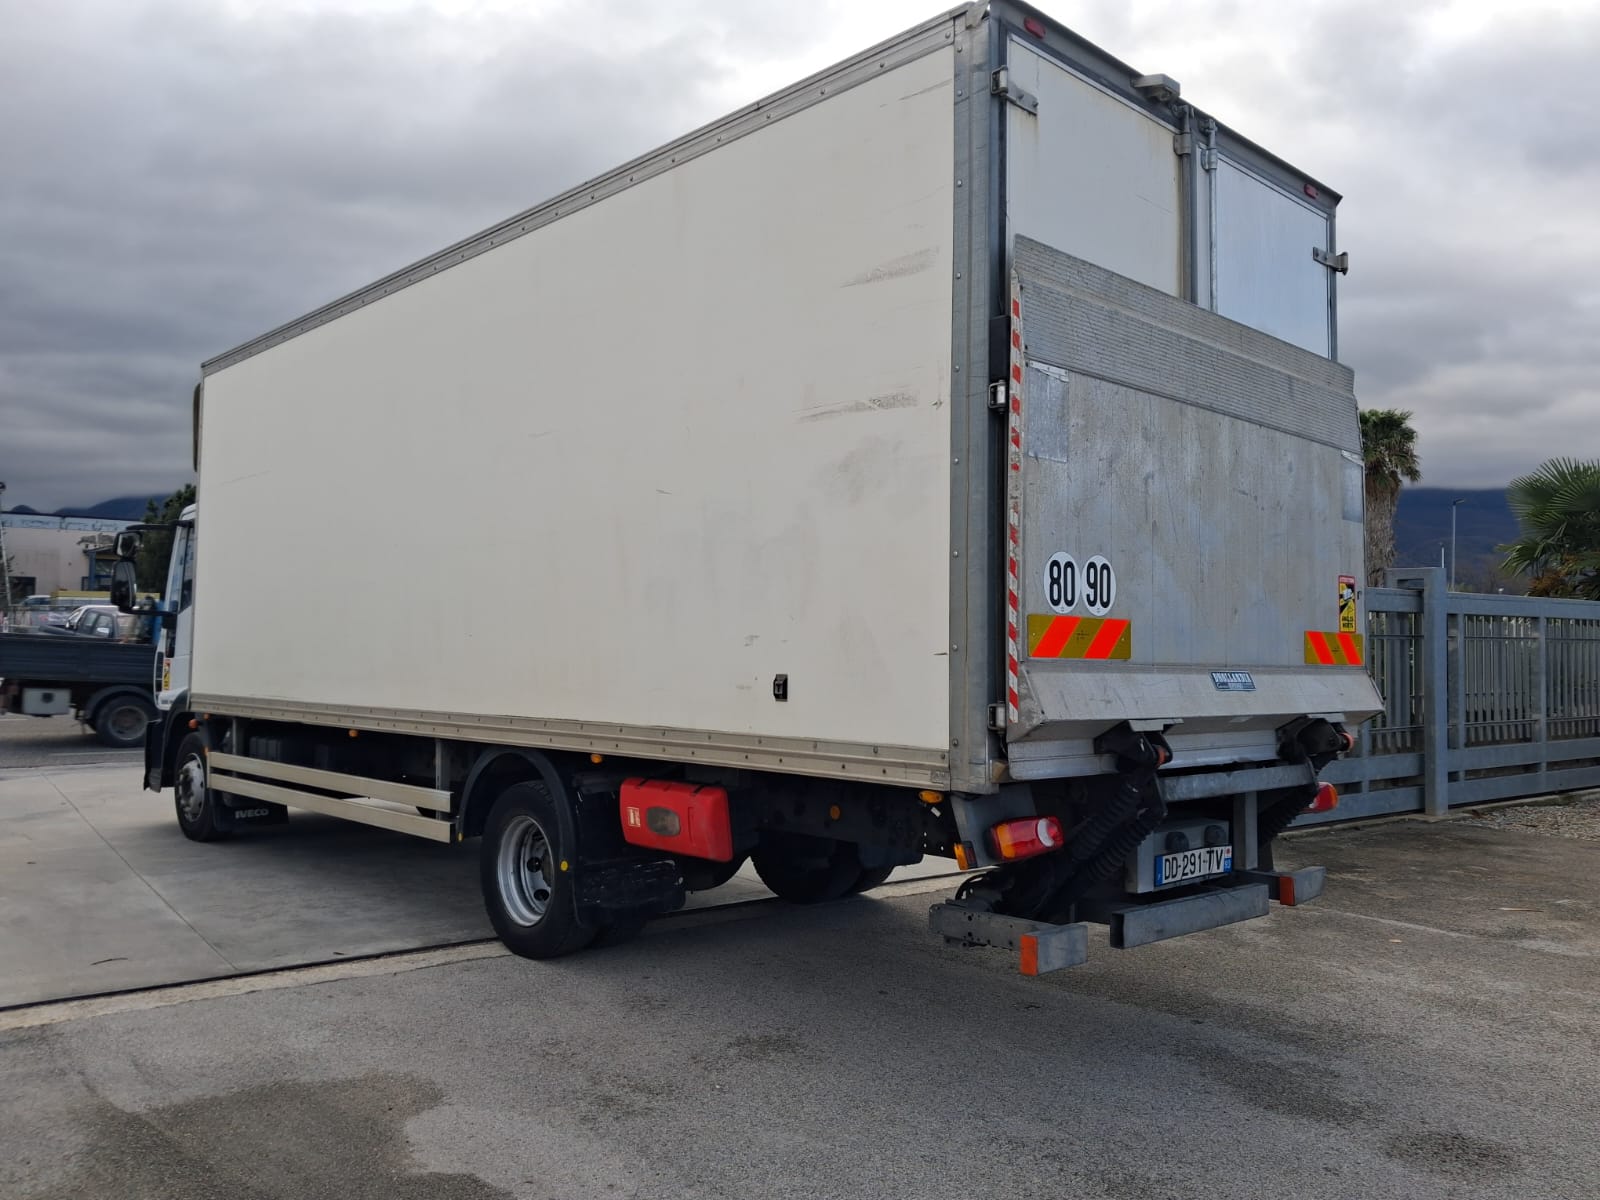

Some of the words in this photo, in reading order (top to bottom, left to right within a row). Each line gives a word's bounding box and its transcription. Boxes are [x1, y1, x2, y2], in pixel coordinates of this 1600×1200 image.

[1049, 559, 1076, 607] 80
[1086, 561, 1111, 609] 90
[234, 808, 269, 819] IVECO
[1164, 849, 1224, 881] DD-291-TV
